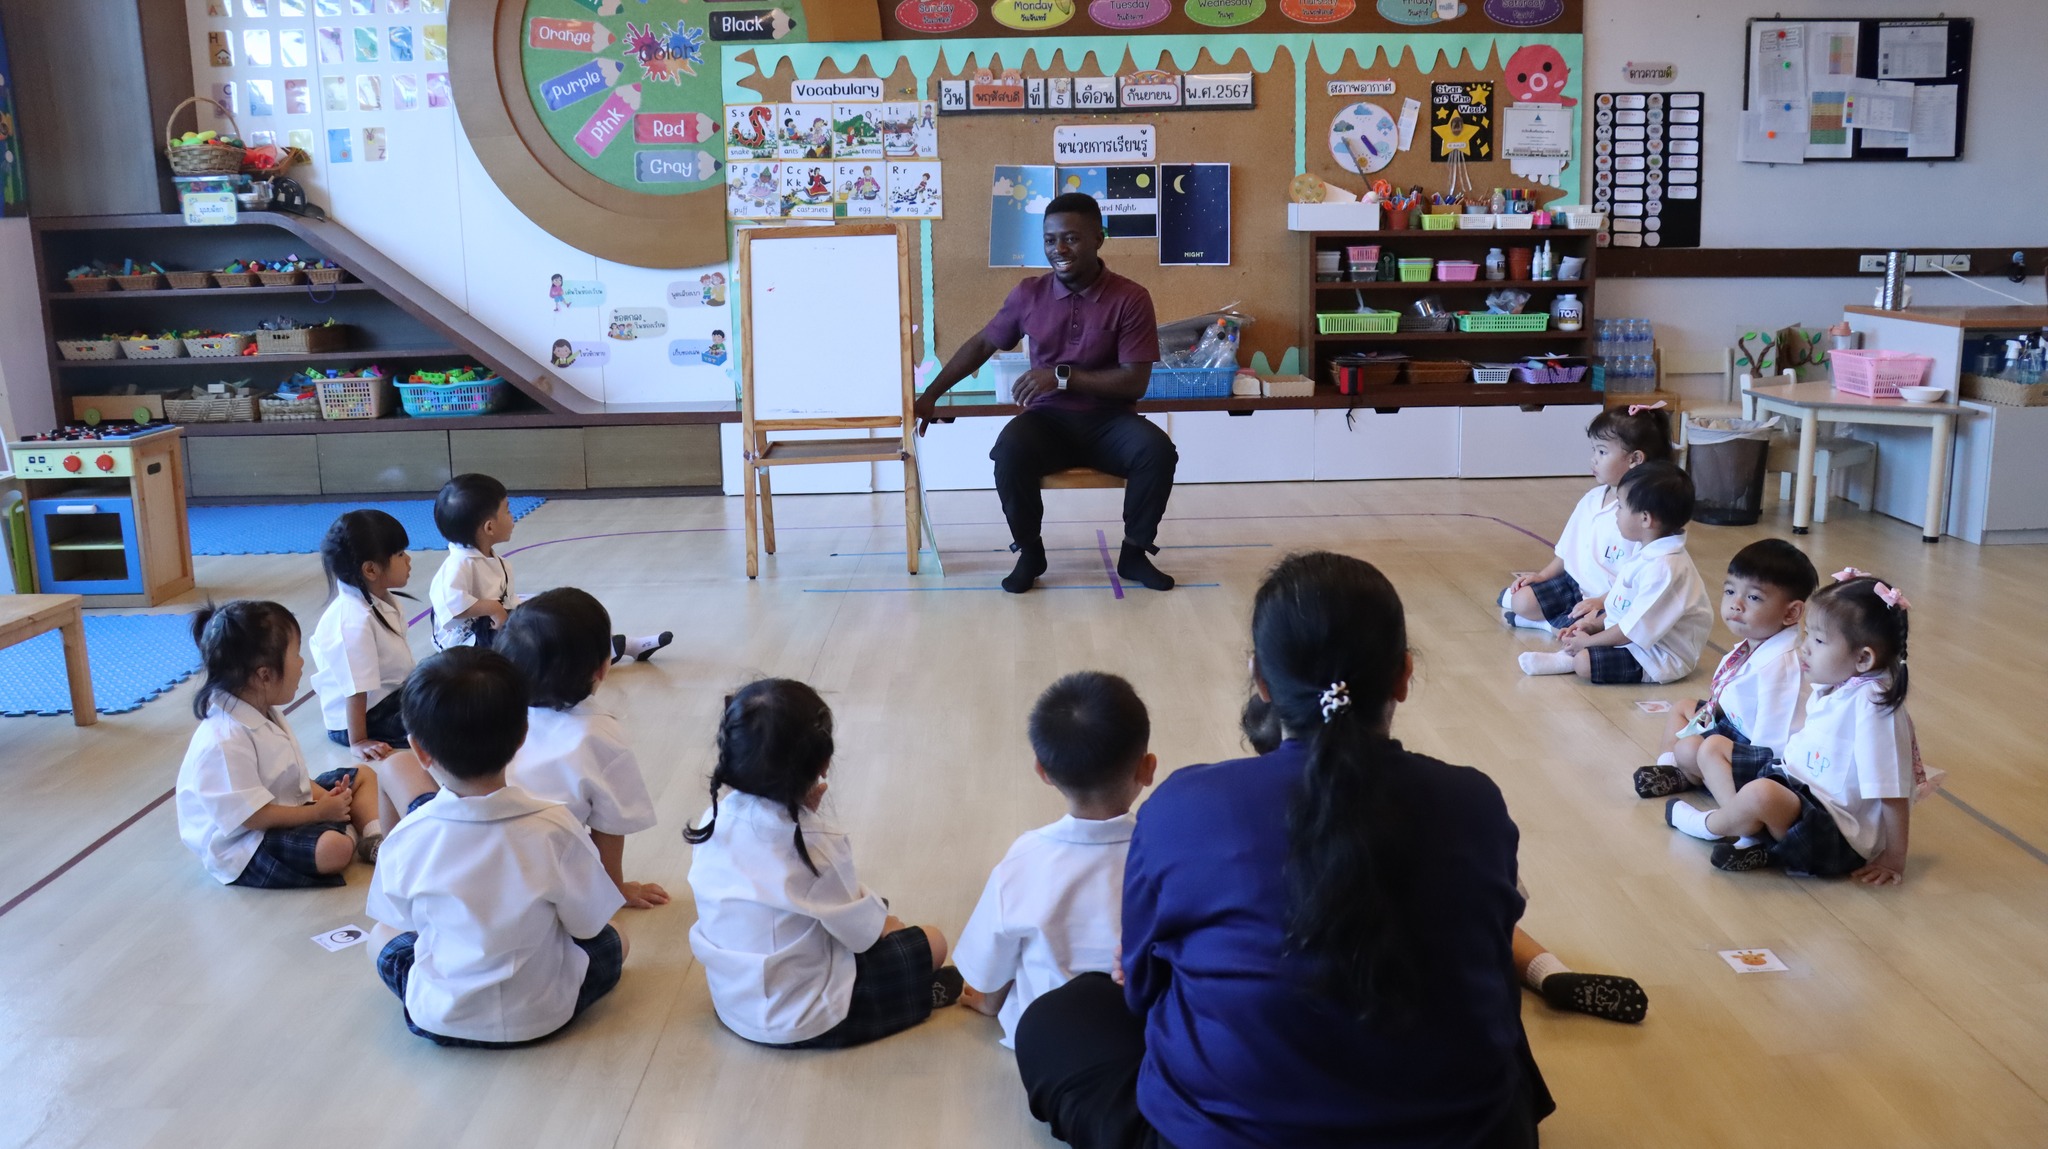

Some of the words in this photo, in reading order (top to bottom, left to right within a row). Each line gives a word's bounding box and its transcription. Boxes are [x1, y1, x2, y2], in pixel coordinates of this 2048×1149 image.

[919, 4, 954, 14] Sunday
[1014, 0, 1053, 12] Monday
[1110, 0, 1150, 10] Tuesday
[722, 16, 763, 32] Black
[209, 32, 218, 43] H
[540, 26, 591, 45] Orange
[640, 42, 695, 63] Color
[1630, 66, 1672, 79] ดาวความดี
[552, 71, 600, 100] Purple
[796, 83, 880, 98] Vocabulary
[1331, 81, 1392, 94] สภาพอากาศ
[1436, 85, 1462, 93] Star
[944, 88, 963, 105] วัน
[976, 90, 1020, 103] พฤหัสบดี
[1030, 83, 1040, 105] ที่
[1057, 95, 1064, 105] 5
[1076, 84, 1115, 104] เดือน
[1127, 88, 1172, 101] กันยายน
[1186, 84, 1249, 99] พ.ศ.2567
[1434, 95, 1449, 104] of
[1450, 94, 1471, 103] the
[732, 110, 737, 118] S
[784, 108, 791, 116] A
[1458, 105, 1487, 114] Week
[591, 107, 624, 142] Pink
[654, 120, 685, 137] Red
[1058, 130, 1148, 157] หน่วยการเรียนรู้
[650, 160, 692, 177] Gray
[732, 165, 738, 173] P
[743, 168, 748, 176] p
[787, 166, 793, 174] C
[840, 167, 845, 175] E
[893, 166, 899, 174] R
[787, 179, 793, 187] K
[734, 206, 748, 216] puff
[859, 206, 871, 215] egg
[907, 206, 919, 214] rag
[1100, 204, 1113, 212] and
[1115, 204, 1136, 213] Night
[614, 309, 642, 322] ข้อตกลง
[1560, 310, 1578, 318] TOA
[1613, 595, 1632, 610] LP
